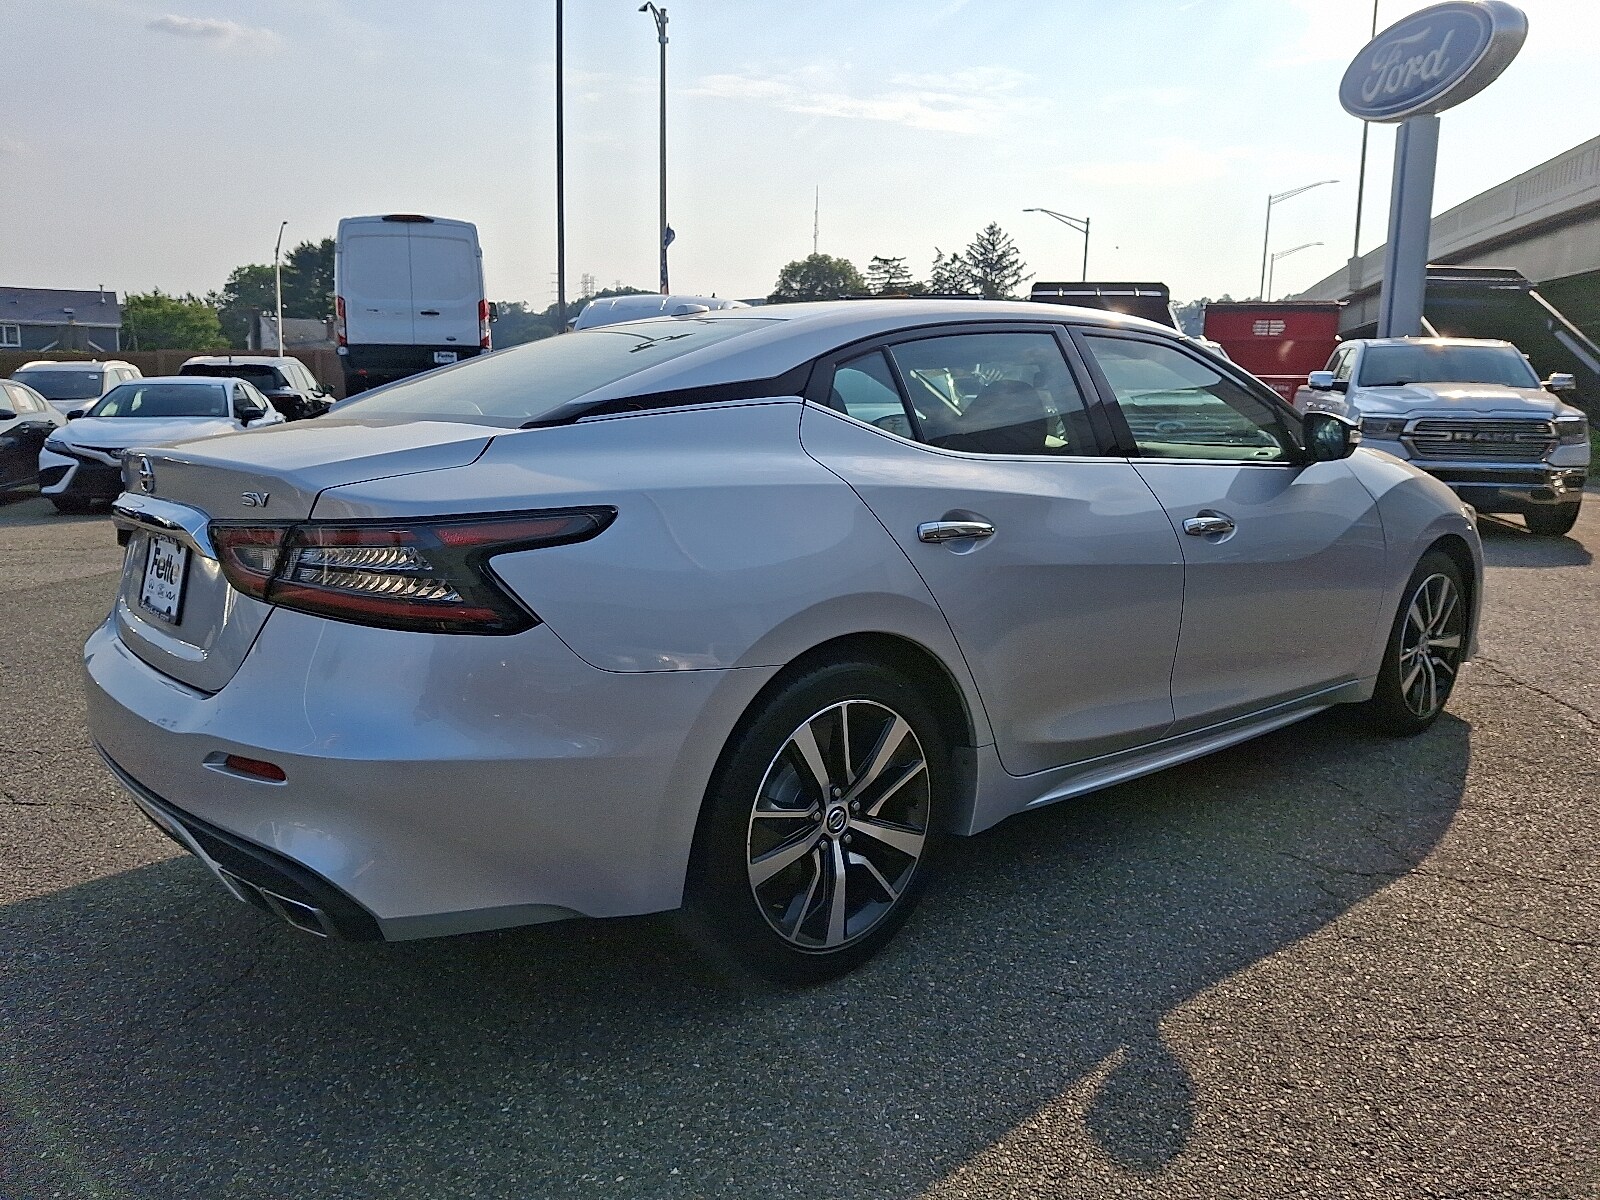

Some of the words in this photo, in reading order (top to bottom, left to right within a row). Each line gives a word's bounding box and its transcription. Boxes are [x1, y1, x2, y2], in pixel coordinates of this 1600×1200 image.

[1361, 26, 1454, 102] Ford
[1454, 431, 1511, 442] RAM
[241, 491, 270, 507] SV
